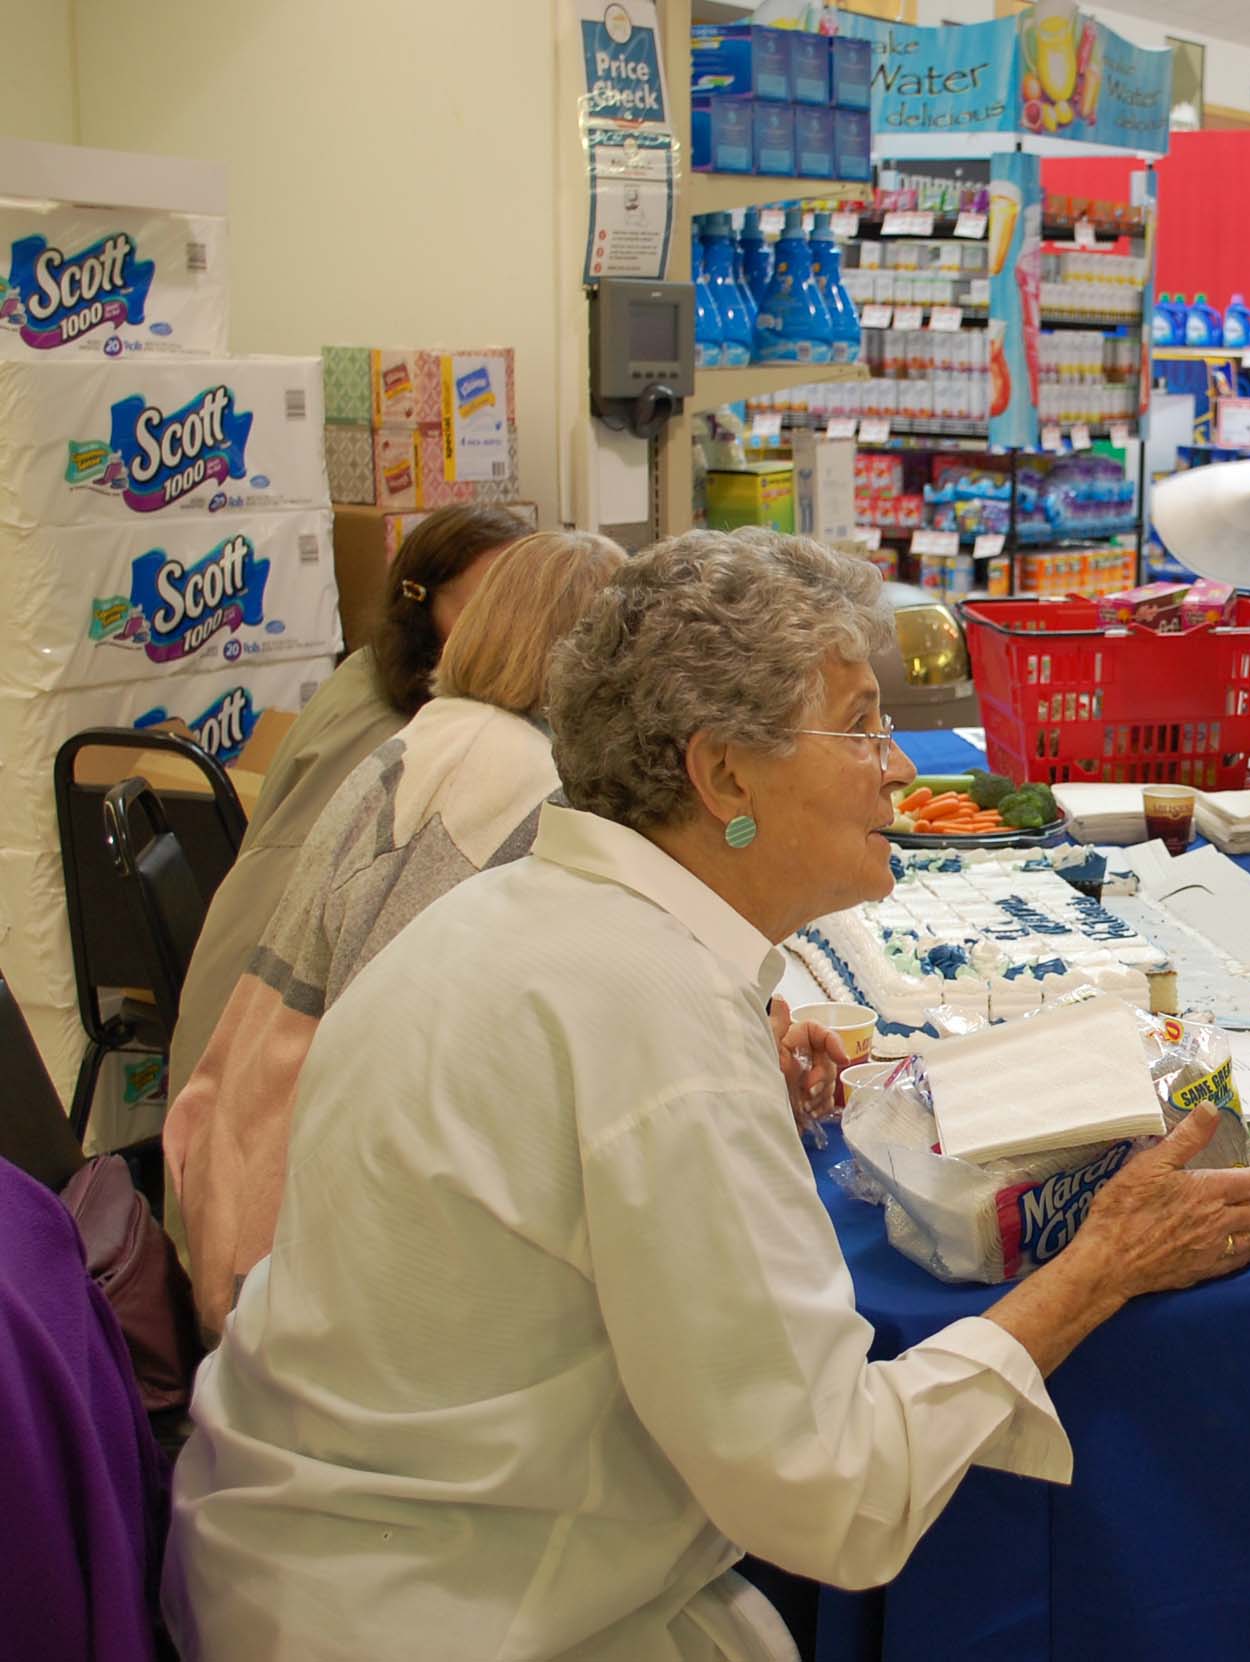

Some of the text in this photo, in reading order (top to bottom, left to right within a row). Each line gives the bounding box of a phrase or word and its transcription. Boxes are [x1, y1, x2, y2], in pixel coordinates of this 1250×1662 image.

[870, 30, 919, 55] ake
[595, 51, 650, 81] Price
[870, 62, 991, 96] Water
[593, 81, 659, 110] Check
[886, 101, 1006, 128] delicious
[28, 233, 131, 320] Scott
[60, 301, 104, 341] 1000
[105, 339, 120, 353] 20
[130, 386, 229, 482] Scott
[164, 458, 205, 501] 1000
[153, 536, 249, 634] Scott
[183, 608, 223, 652] 1000
[225, 642, 240, 657] 20
[192, 687, 246, 756] ott
[1181, 1080, 1213, 1107] SAME
[1021, 1143, 1127, 1245] Mardi
[1035, 1178, 1108, 1260] Gra
